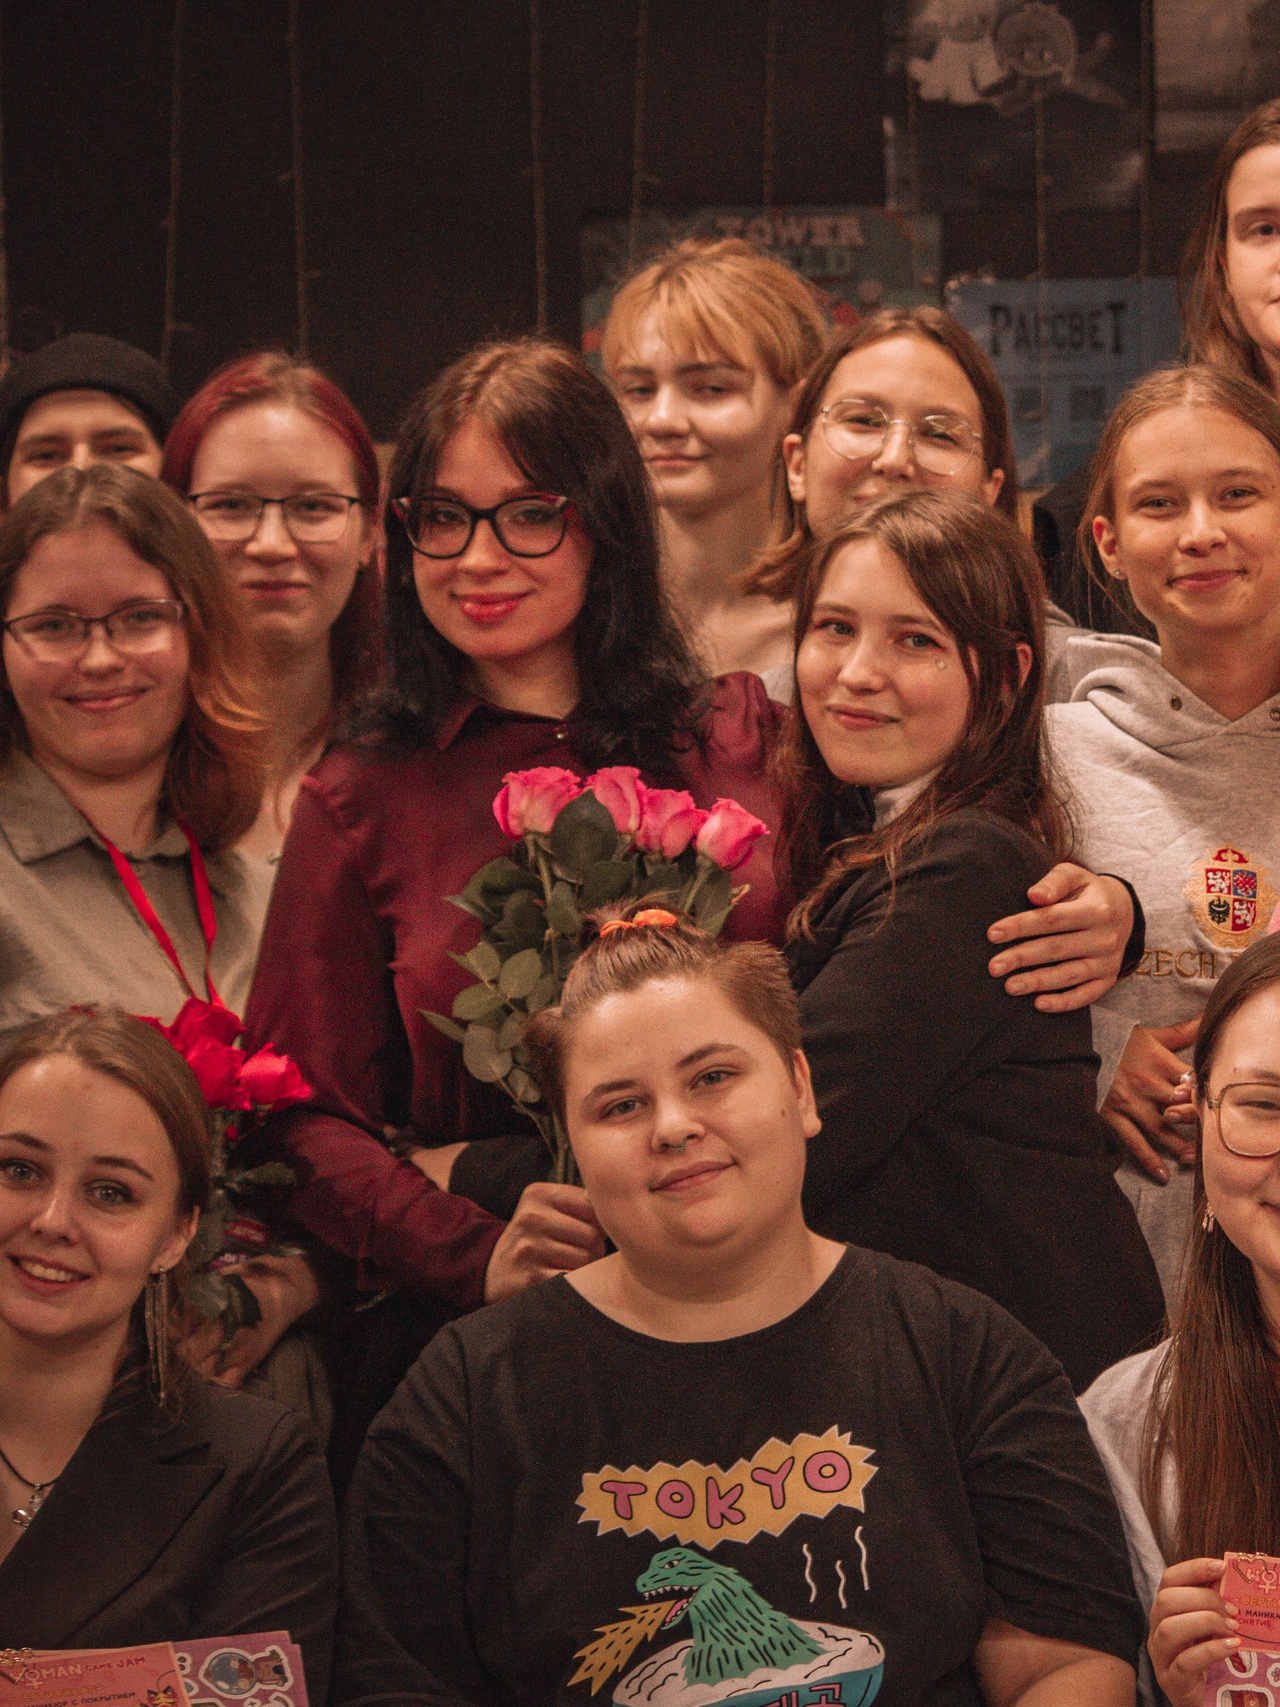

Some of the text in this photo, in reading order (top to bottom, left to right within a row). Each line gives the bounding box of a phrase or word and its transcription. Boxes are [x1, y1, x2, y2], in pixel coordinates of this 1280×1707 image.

[1133, 949, 1218, 979] ZECH
[600, 1450, 851, 1528] TOKYO
[117, 1656, 146, 1668] JAM
